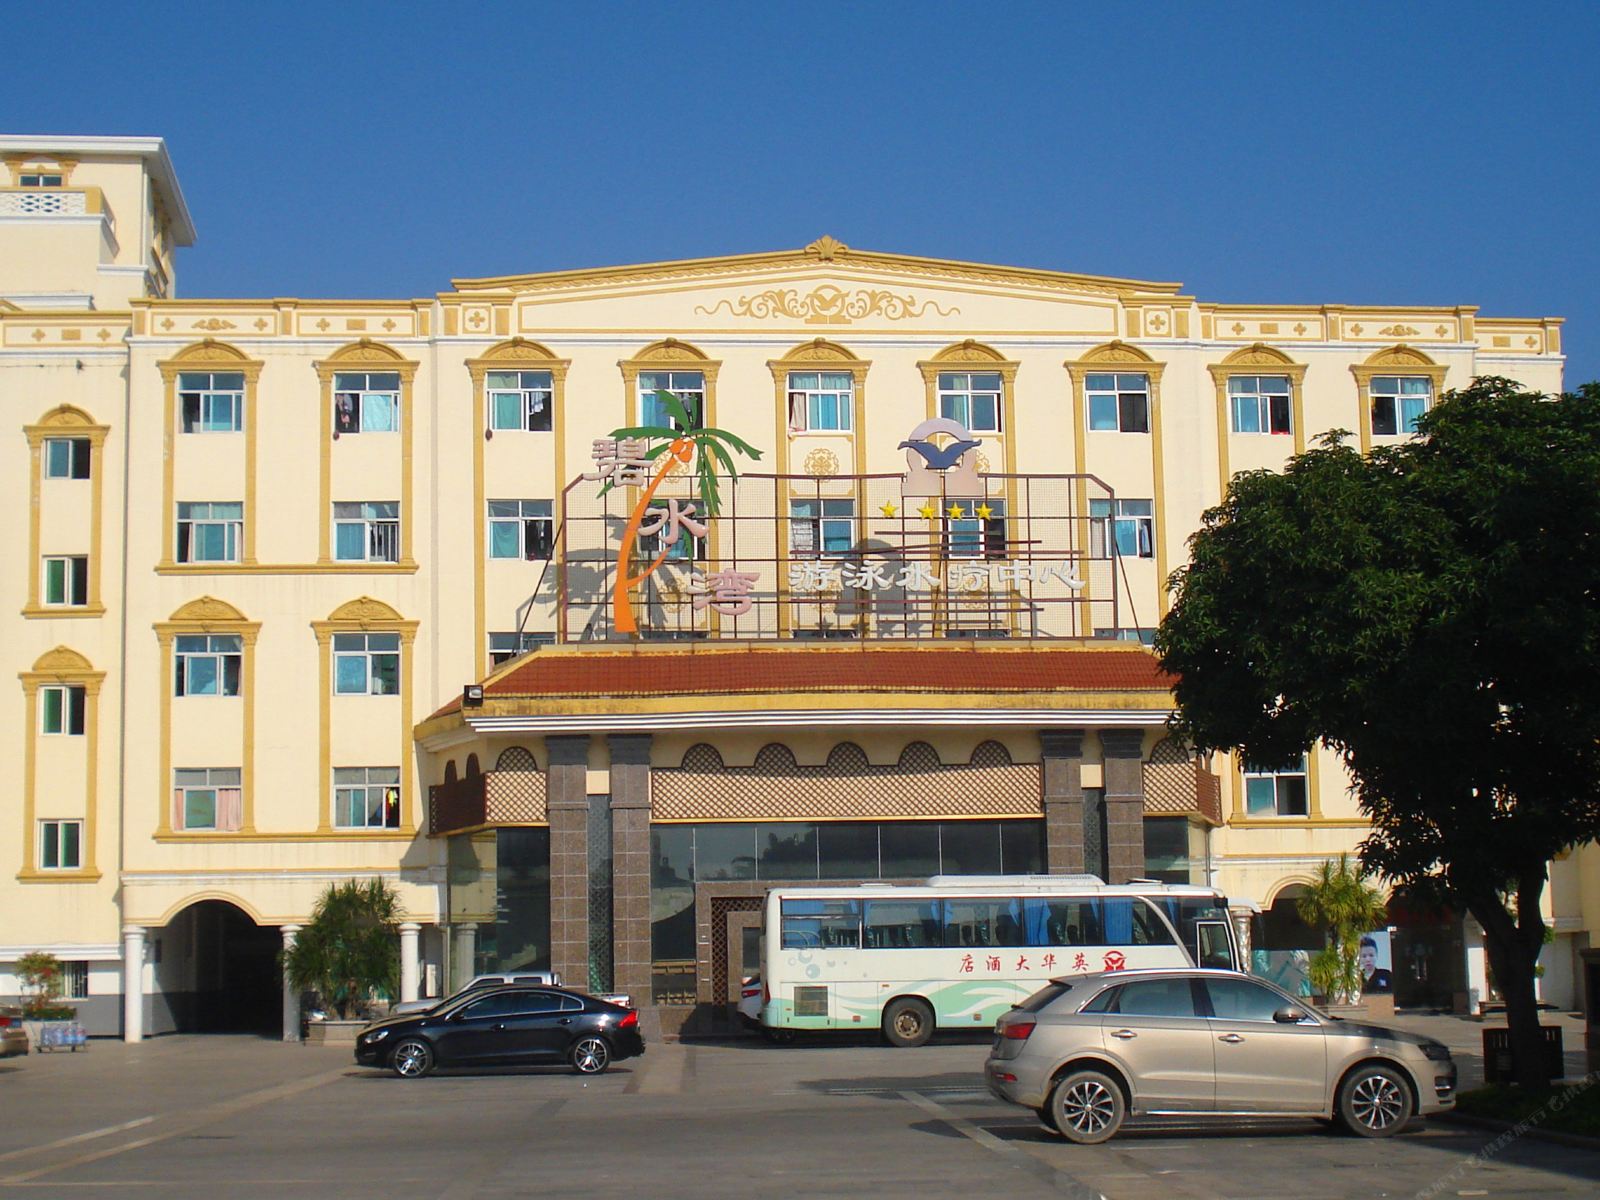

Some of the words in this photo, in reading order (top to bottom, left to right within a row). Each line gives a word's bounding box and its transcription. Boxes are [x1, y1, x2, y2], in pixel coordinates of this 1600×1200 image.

[580, 436, 761, 615] 碧水湾
[789, 560, 1086, 591] 游泳水疗中心
